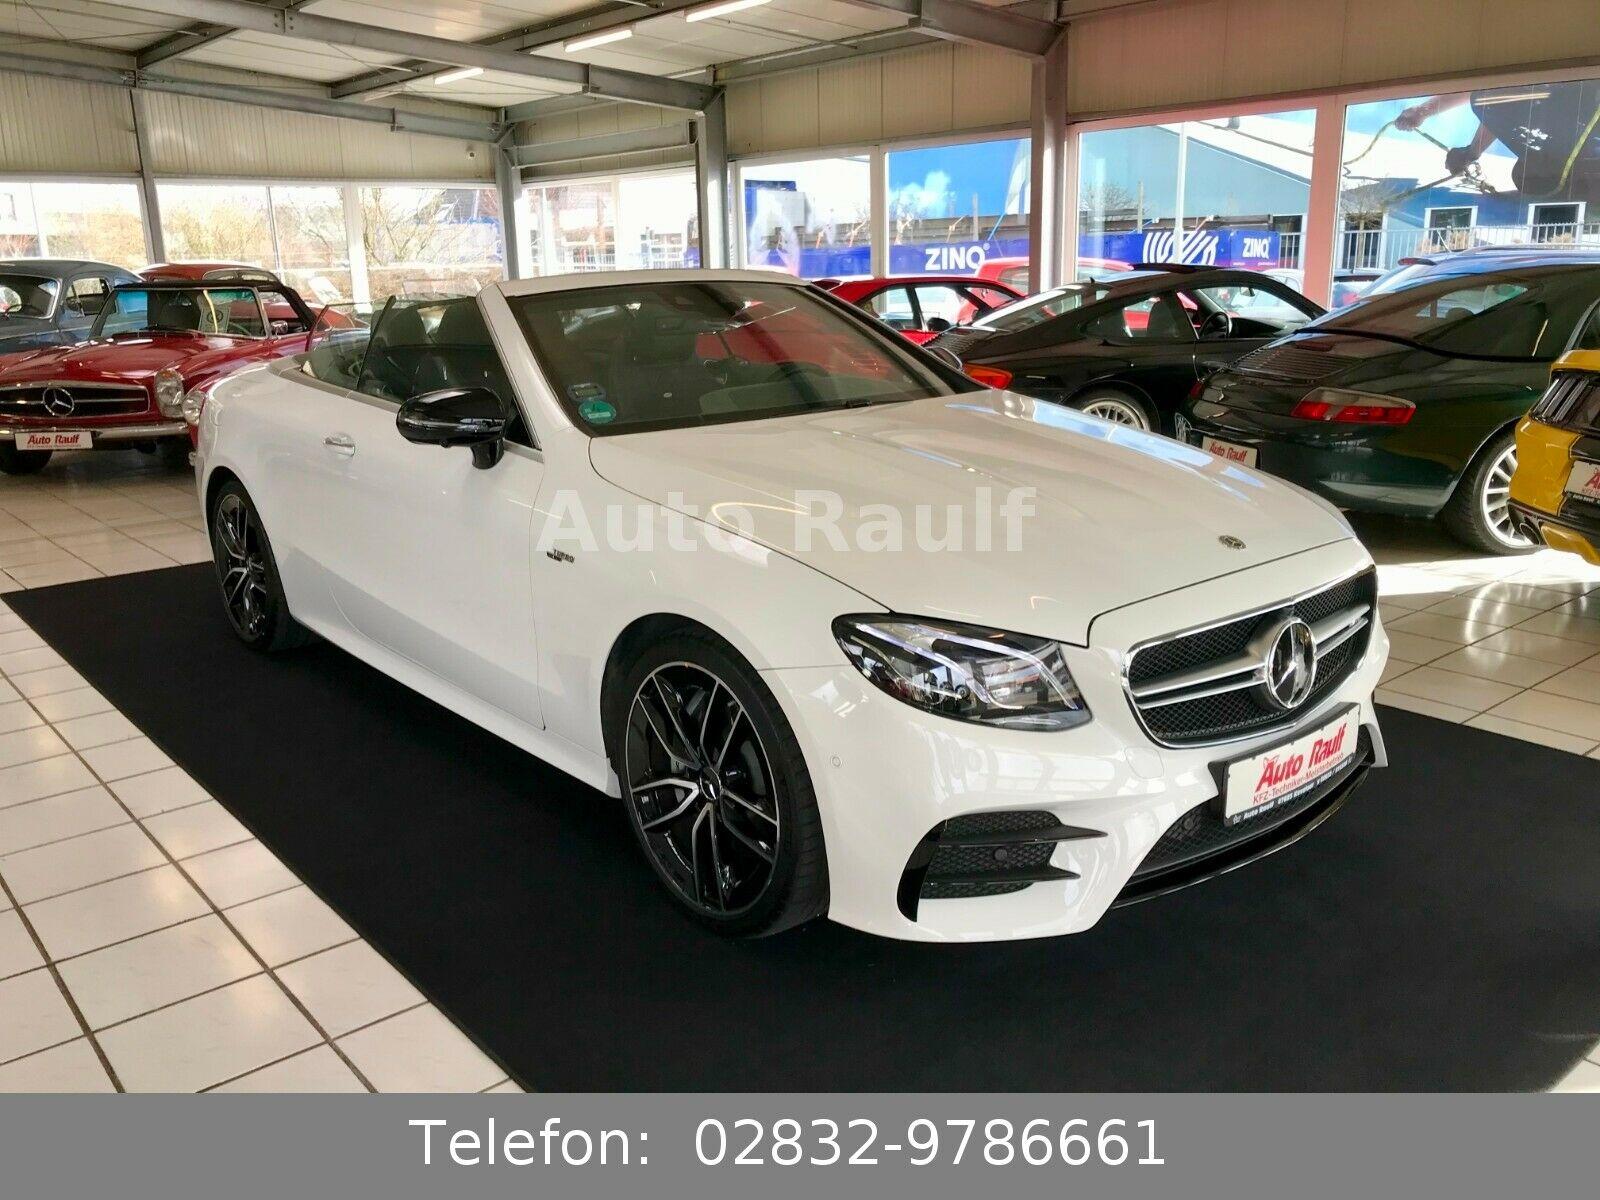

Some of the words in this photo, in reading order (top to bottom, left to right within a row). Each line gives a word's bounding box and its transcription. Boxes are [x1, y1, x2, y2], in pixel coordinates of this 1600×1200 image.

[1242, 236, 1269, 259] ZINQ
[27, 434, 51, 445] Auto
[1208, 441, 1226, 457] Auto
[1255, 754, 1304, 793] Auto
[1308, 722, 1348, 769] Raulf
